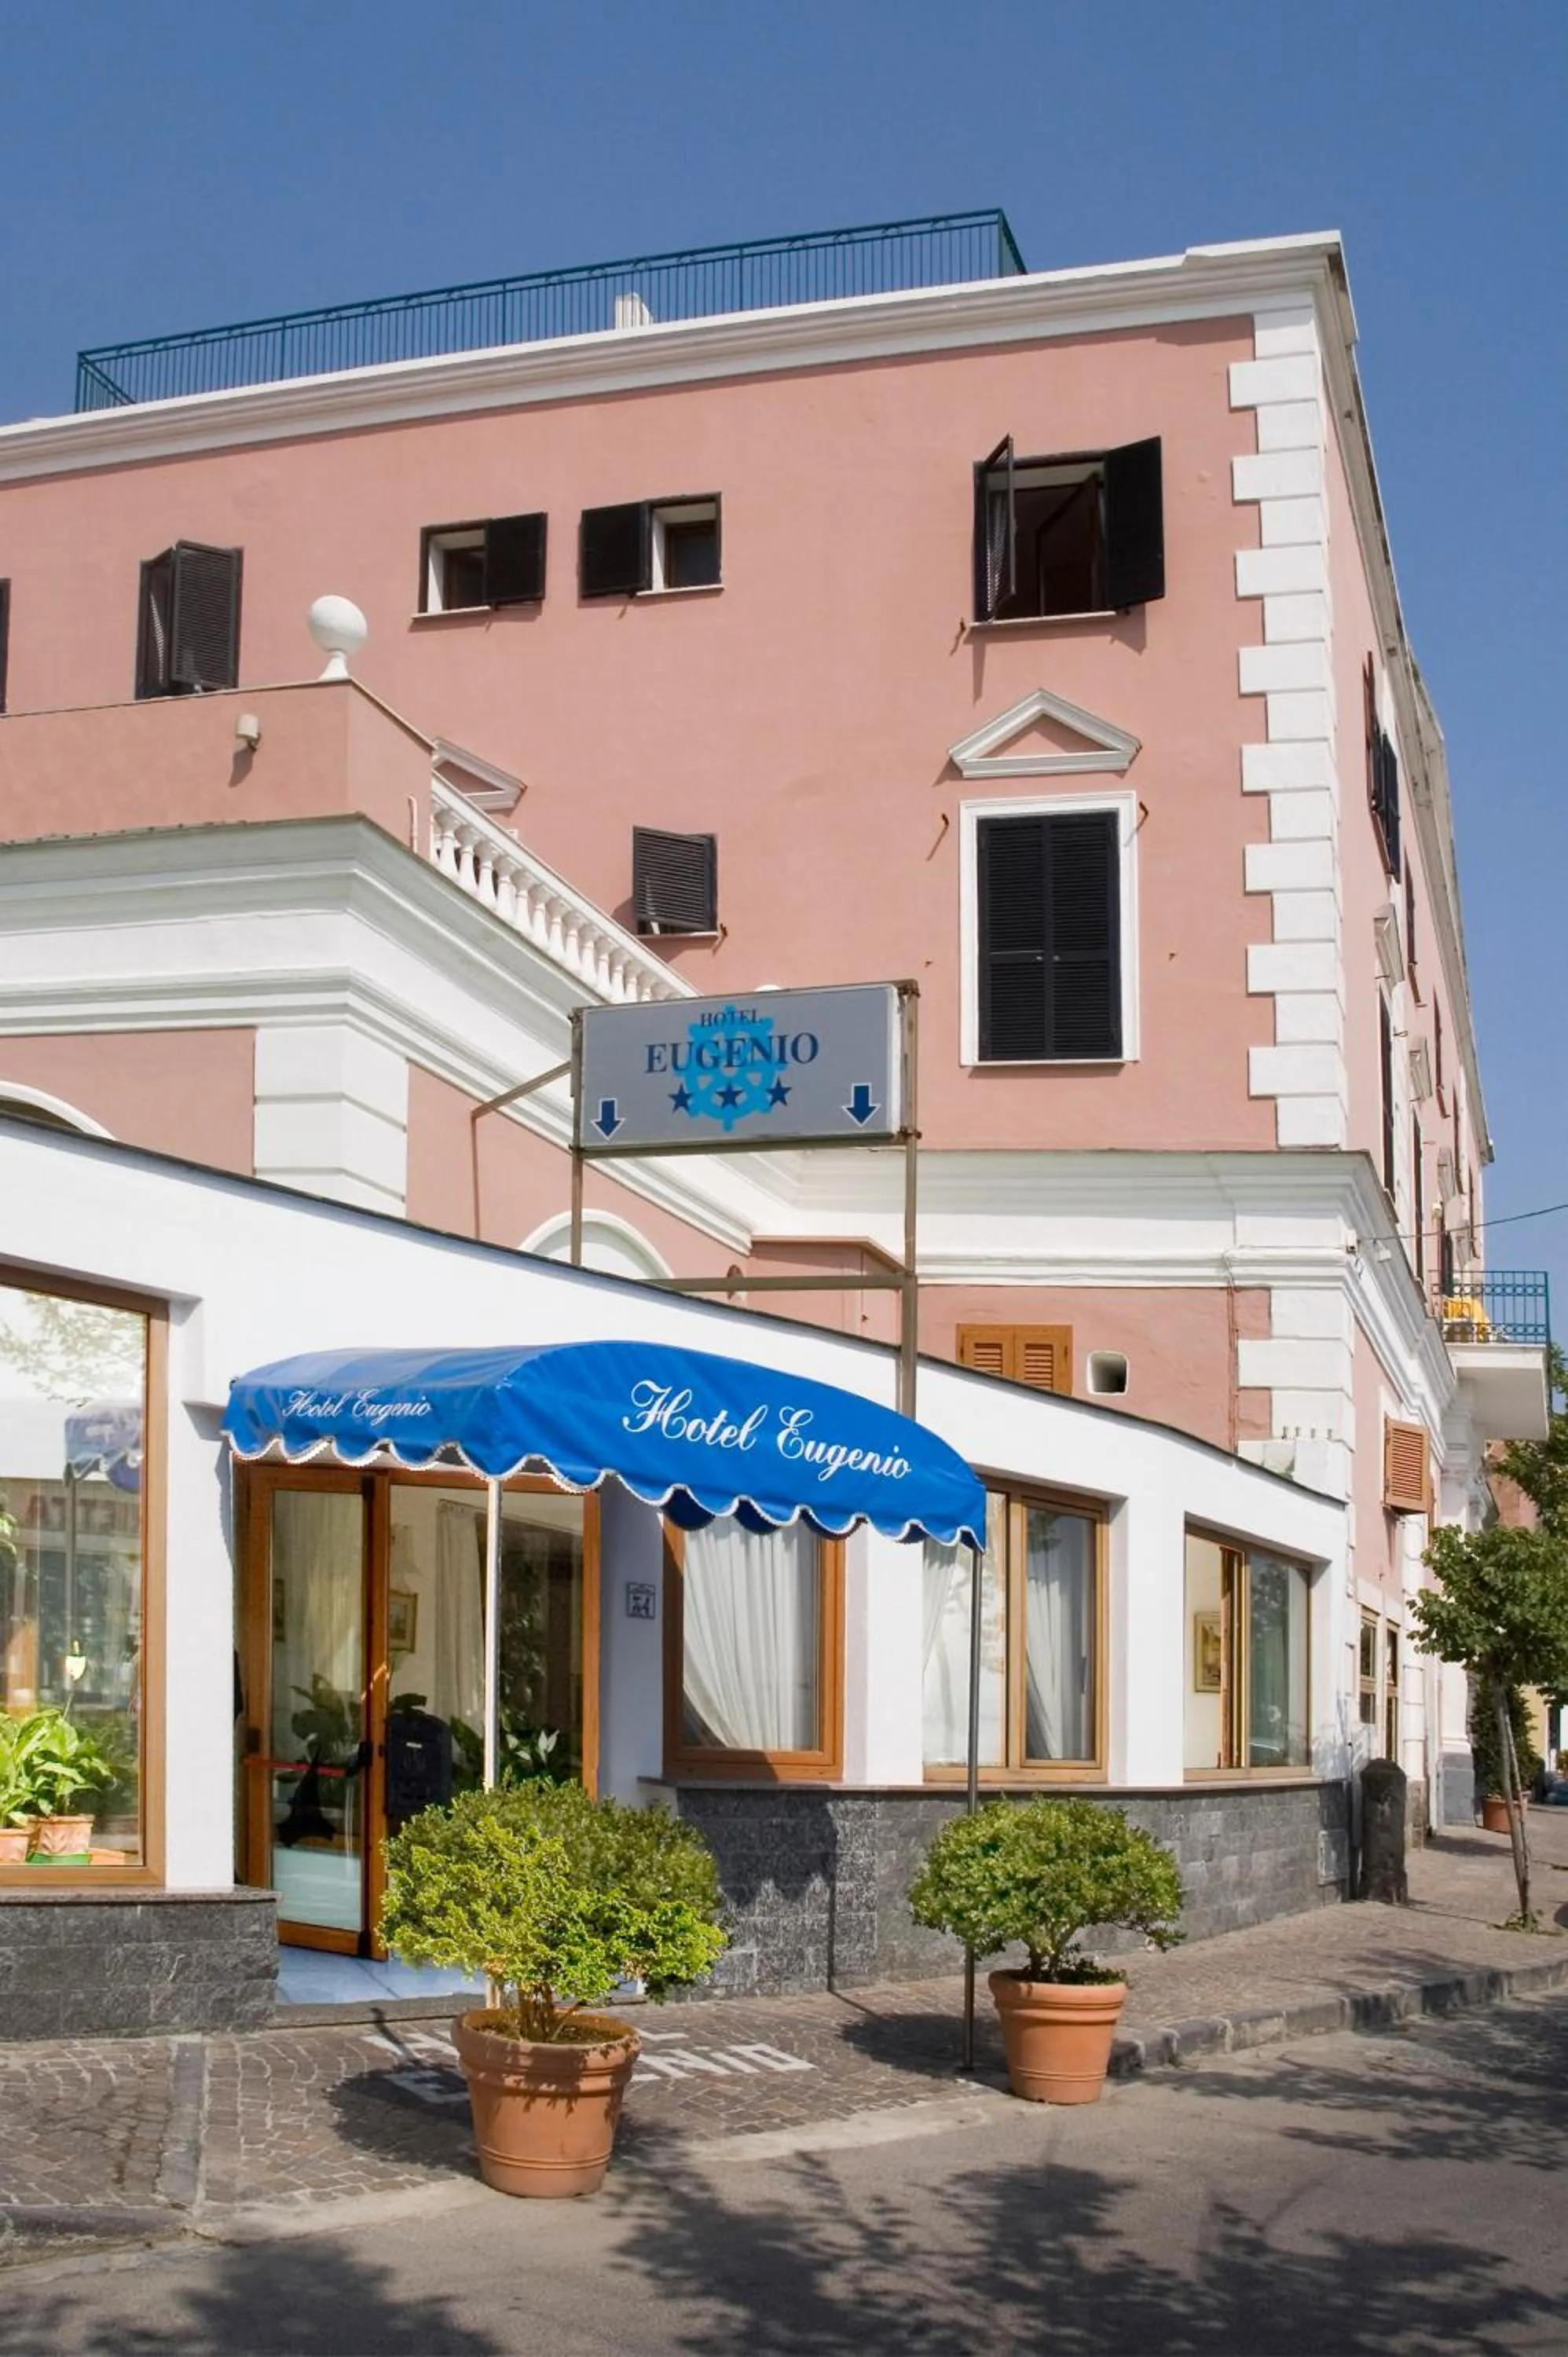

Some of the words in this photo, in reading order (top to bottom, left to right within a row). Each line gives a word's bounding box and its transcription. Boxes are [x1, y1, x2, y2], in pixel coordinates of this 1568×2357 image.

[700, 1009, 762, 1028] HOTEL
[644, 1032, 819, 1074] EUGENIO
[283, 1389, 353, 1417] Hotel
[352, 1387, 432, 1426] Eugenio
[622, 1380, 768, 1451] Hotel
[776, 1406, 912, 1482] Eugenio
